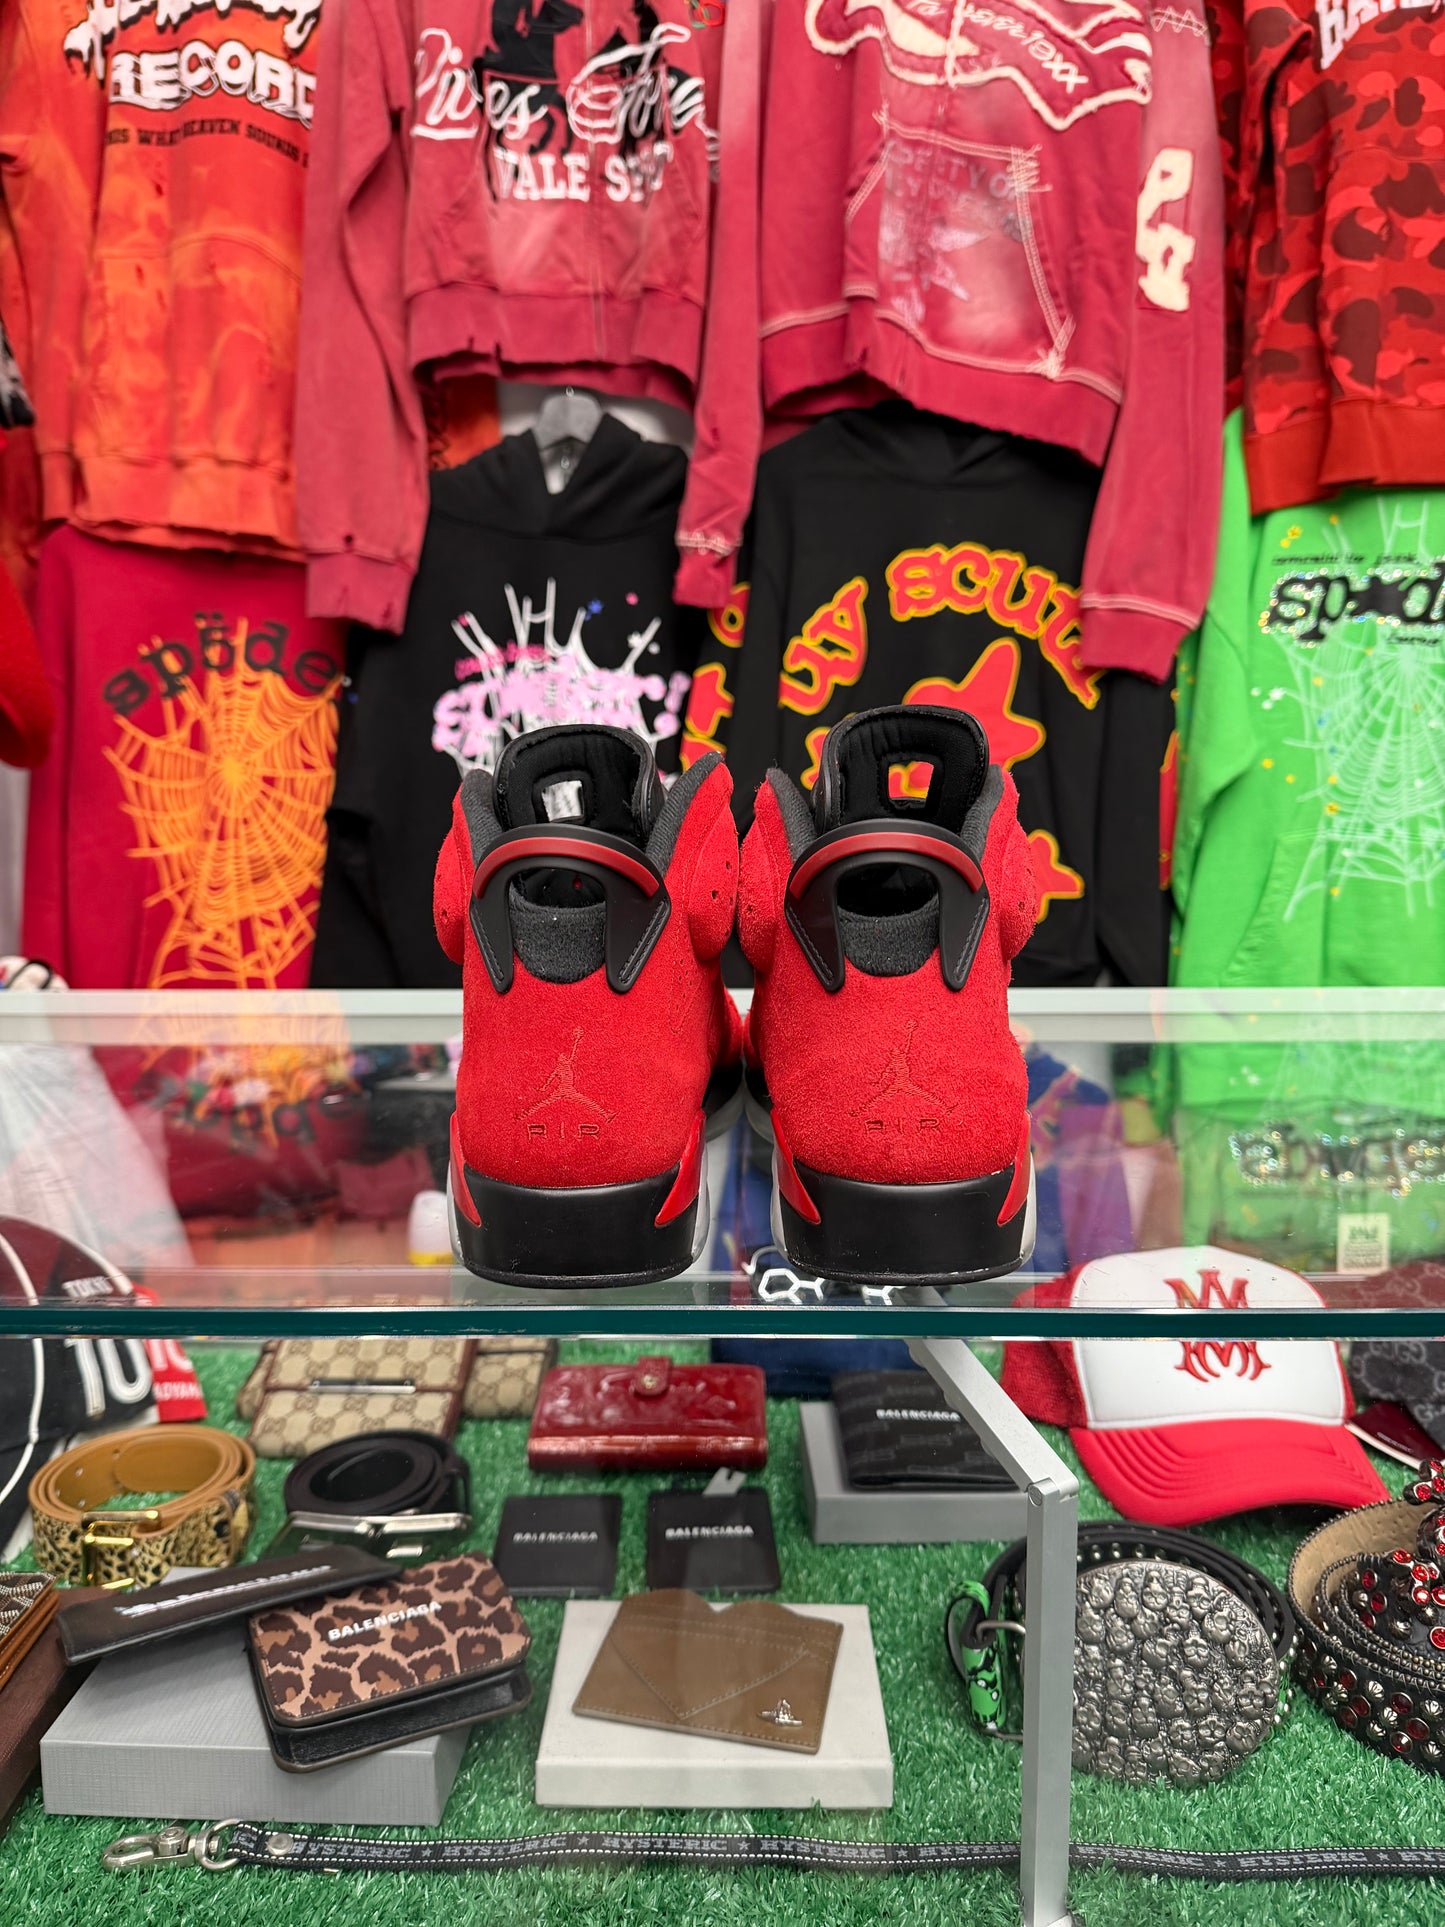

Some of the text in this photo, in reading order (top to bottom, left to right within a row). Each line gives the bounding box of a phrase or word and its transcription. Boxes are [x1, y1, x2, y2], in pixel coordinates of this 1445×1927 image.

[493, 147, 590, 202] VALE
[527, 1123, 600, 1140] AIR
[864, 1117, 941, 1133] AIR
[876, 1408, 961, 1422] BALENCIAGA
[513, 1531, 599, 1544] BALENCIAGA
[665, 1525, 754, 1540] BALENCIAGA
[327, 1600, 442, 1642] BALENCIAGA
[442, 1836, 567, 1857] HYSTERIC
[602, 1835, 728, 1851] HYSTERIC
[760, 1839, 886, 1859] HYSTERIC
[1239, 1850, 1368, 1867] HYSTERIC
